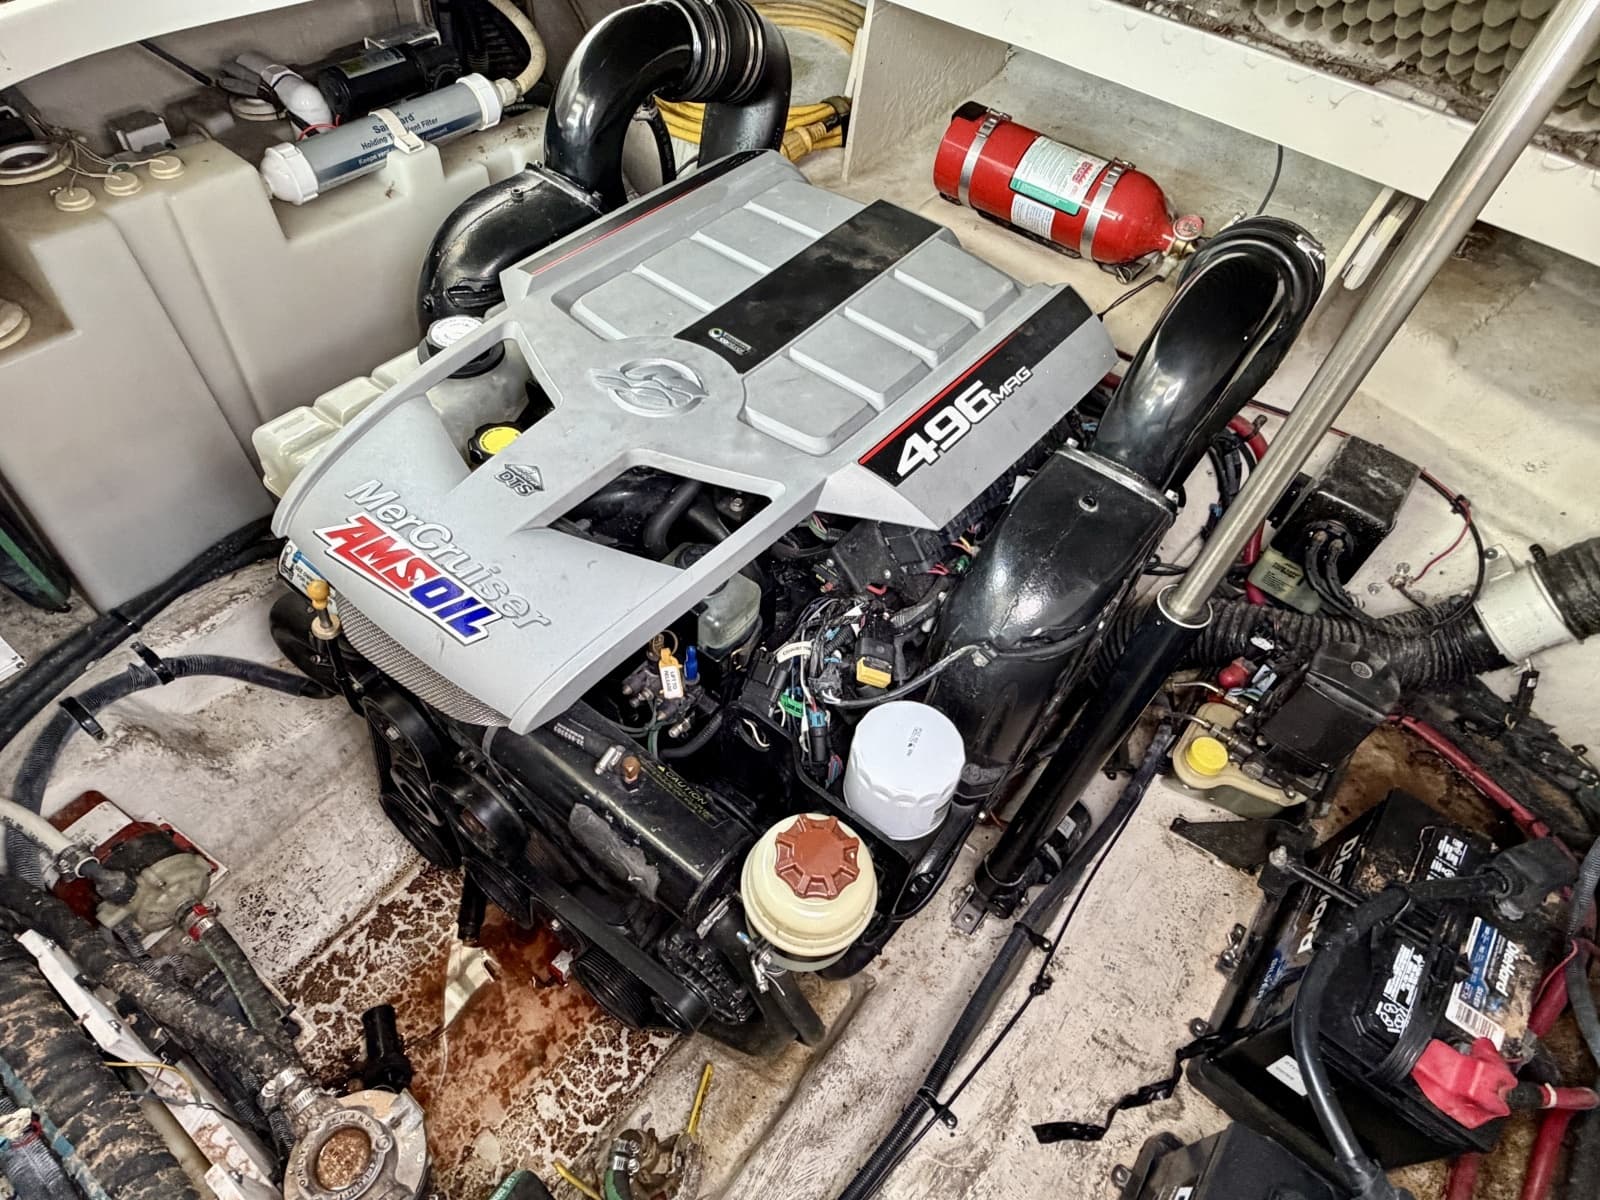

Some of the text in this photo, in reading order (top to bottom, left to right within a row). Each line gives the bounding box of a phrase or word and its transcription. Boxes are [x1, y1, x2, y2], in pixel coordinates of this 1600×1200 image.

[361, 136, 388, 150] Holding
[422, 117, 438, 129] Filter
[896, 366, 1032, 477] 496 MAG
[497, 470, 534, 495] DTS
[322, 515, 498, 638] AMSOIL
[344, 479, 552, 629] MerCruiser
[665, 770, 709, 806] CAUTION
[1495, 940, 1521, 997] DieHard
